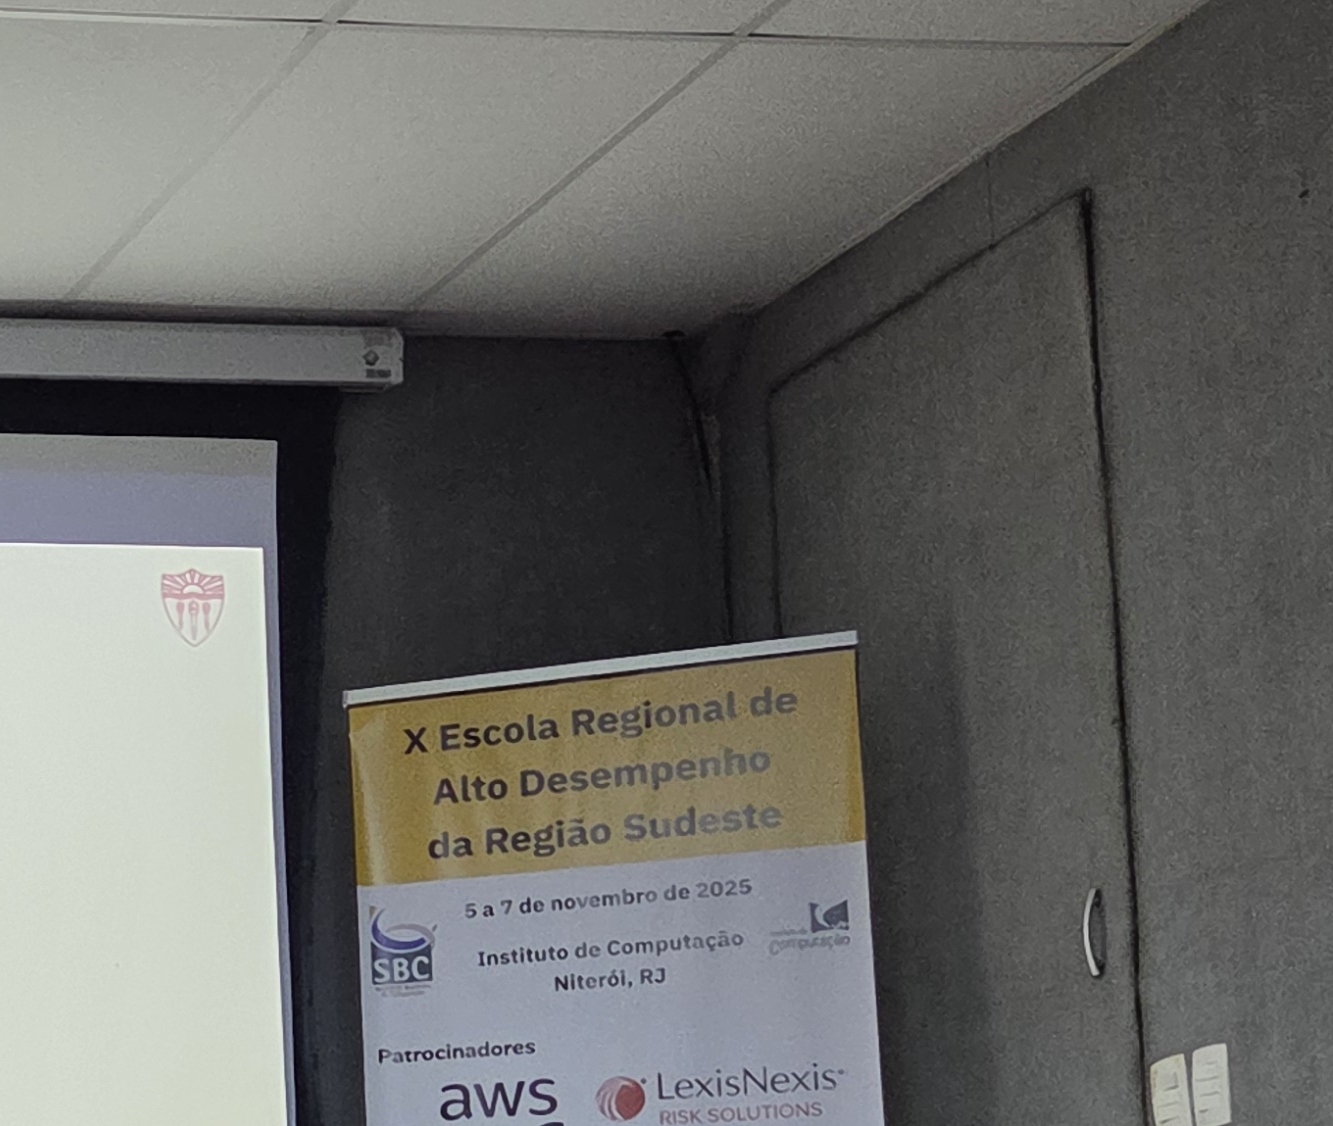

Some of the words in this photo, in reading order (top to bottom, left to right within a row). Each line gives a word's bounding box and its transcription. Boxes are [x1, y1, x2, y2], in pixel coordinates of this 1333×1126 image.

[404, 726, 428, 755] X
[440, 713, 559, 752] Escola
[572, 690, 737, 738] Regional
[749, 685, 798, 719] de
[433, 772, 508, 806] Alto
[520, 746, 771, 799] Desempenho
[427, 830, 473, 860] da
[485, 817, 612, 858] Região
[624, 801, 784, 842] Sudeste
[464, 902, 477, 919] 5
[483, 903, 495, 918] a
[500, 899, 513, 915] 7
[519, 896, 544, 915] de
[551, 888, 658, 912] novembro
[663, 883, 690, 902] de
[695, 877, 753, 899] 2025
[478, 945, 569, 967] Instituto
[574, 941, 601, 959] de
[607, 929, 745, 957] Computação
[373, 955, 430, 984] SBC
[640, 967, 666, 985] RJ
[378, 1039, 536, 1065] Patrocinadores
[440, 1077, 559, 1121] aws
[657, 1062, 838, 1100] LexisNexis
[659, 1109, 702, 1126] RISK
[707, 1101, 823, 1122] SOLUTIONS
